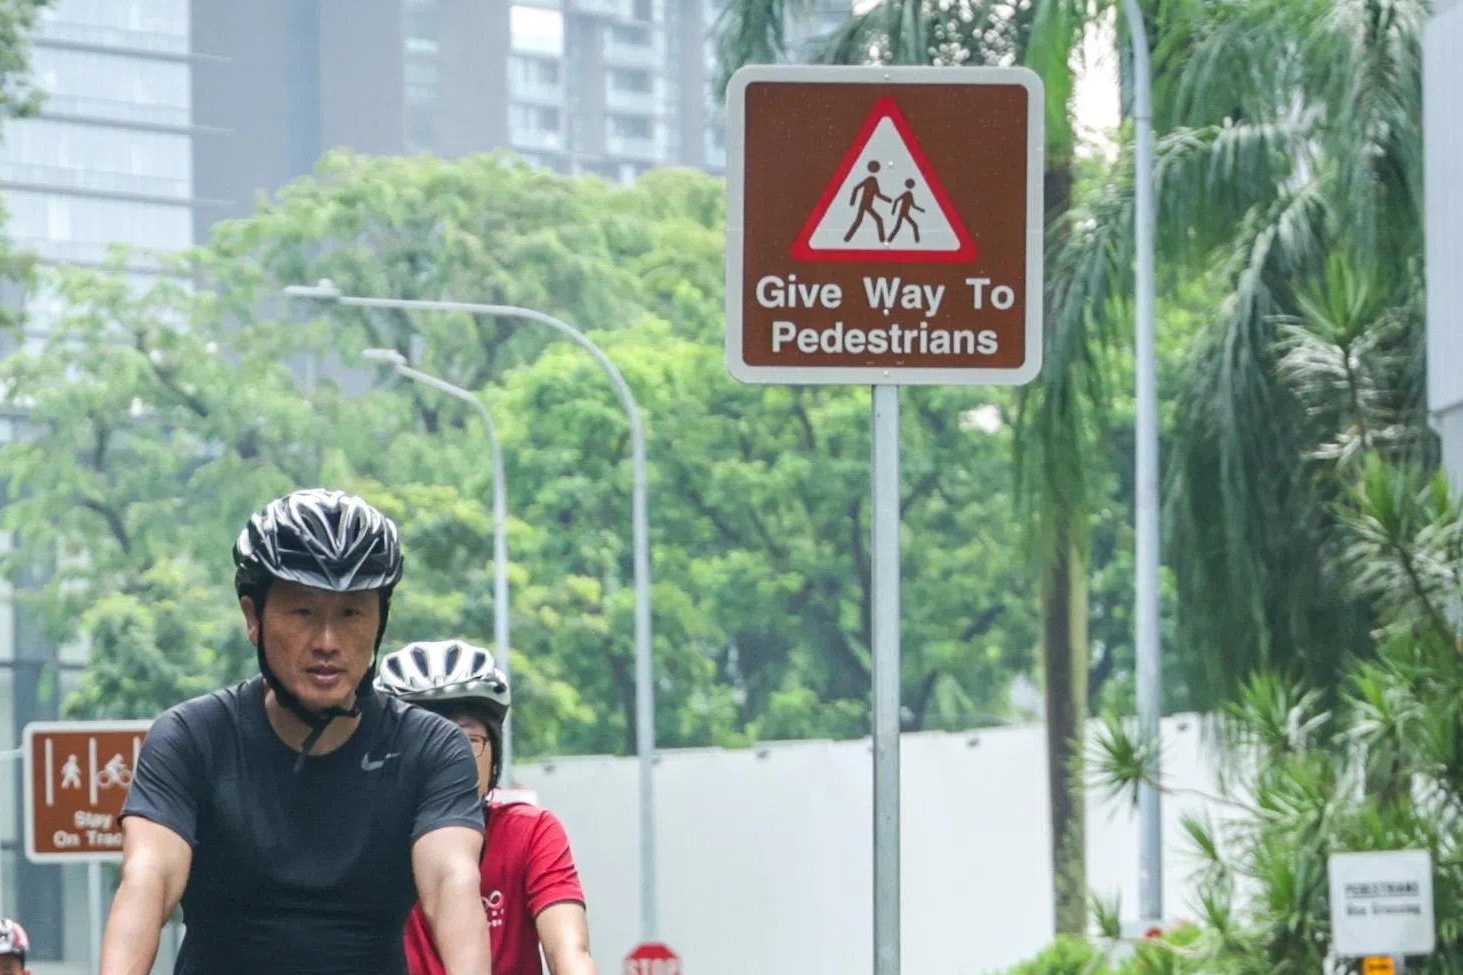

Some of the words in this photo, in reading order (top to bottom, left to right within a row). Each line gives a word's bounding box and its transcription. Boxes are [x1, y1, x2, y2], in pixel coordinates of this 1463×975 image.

[755, 274, 843, 309] Give
[863, 276, 946, 318] Way
[965, 277, 1016, 310] To
[771, 320, 999, 355] Pedestrians
[74, 810, 112, 830] Stay
[53, 830, 80, 848] On
[85, 830, 123, 847] Trac
